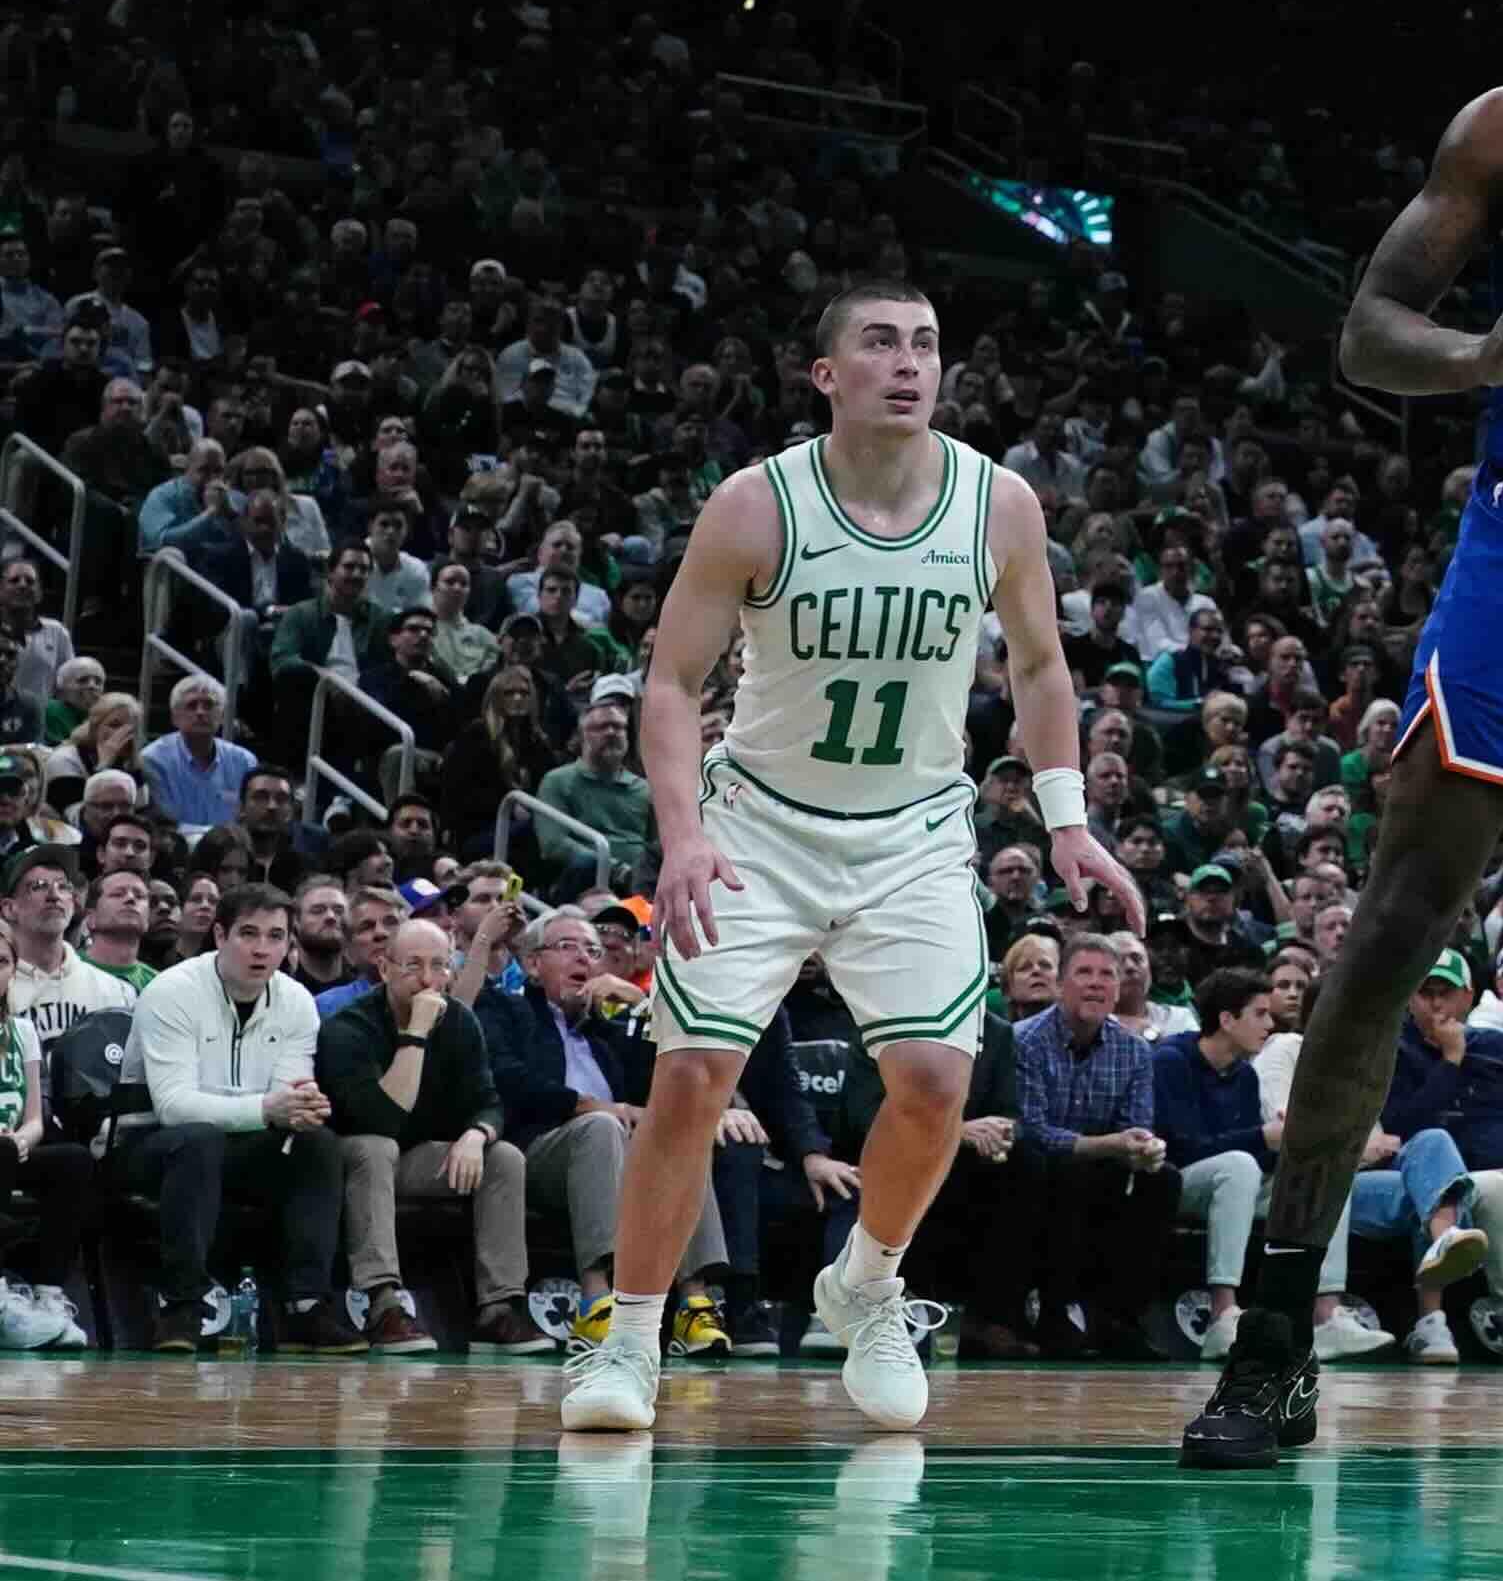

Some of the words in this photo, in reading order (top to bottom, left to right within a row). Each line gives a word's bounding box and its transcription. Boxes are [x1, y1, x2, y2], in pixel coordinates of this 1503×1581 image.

[921, 549, 970, 565] Amica
[790, 586, 971, 662] CELTICS
[810, 678, 909, 765] 11
